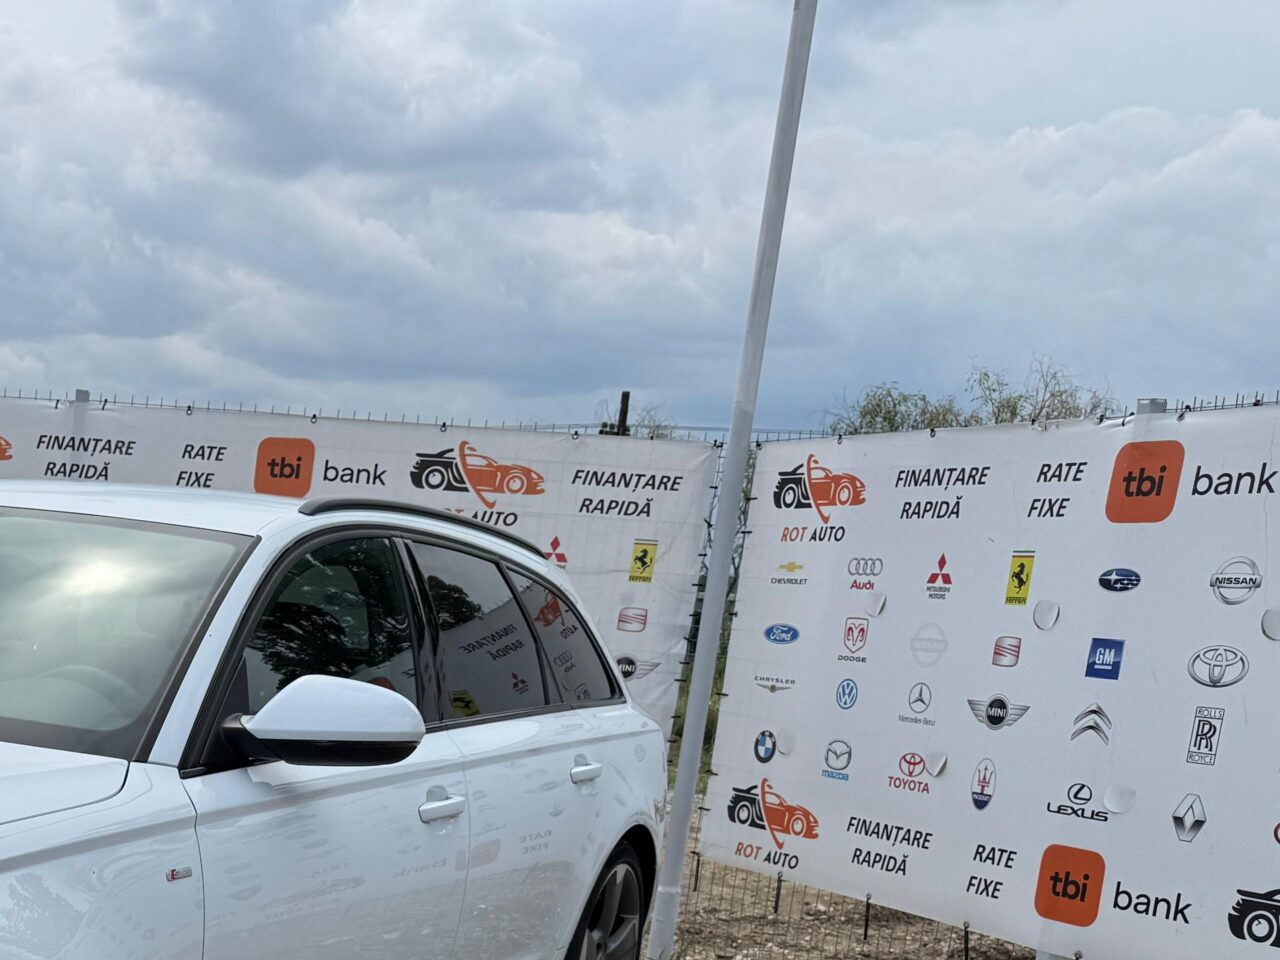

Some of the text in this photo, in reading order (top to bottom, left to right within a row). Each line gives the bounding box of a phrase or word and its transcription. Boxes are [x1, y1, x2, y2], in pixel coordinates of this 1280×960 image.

[36, 433, 137, 457] FINANȚARE
[181, 444, 227, 462] RATE
[44, 460, 111, 481] RAPIDĂ
[176, 471, 215, 488] FIXE
[267, 456, 388, 486] tbi bank
[571, 469, 684, 492] FINANȚARE
[895, 466, 991, 491] FINANȚARE
[1036, 462, 1088, 483] RATE
[1122, 463, 1280, 497] tbi bank
[579, 497, 655, 518] RAPIDĂ
[900, 495, 963, 519] RAPIDĂ
[1027, 498, 1070, 518] FIXE
[781, 525, 846, 543] ROT AUTO
[770, 577, 808, 585] CHEVROLET
[1214, 575, 1258, 585] NISSAN
[771, 627, 794, 641] Ford
[837, 655, 867, 663] DODGE
[1095, 648, 1116, 665] GM
[754, 675, 796, 685] CHRYSLER
[988, 706, 1007, 718] MINI
[1198, 708, 1223, 718] ROLLS
[1188, 753, 1215, 764] ROYCE
[888, 776, 930, 794] TOYOTA
[1046, 802, 1108, 822] LEXUS
[846, 816, 933, 850] FINANȚARE
[734, 841, 800, 870] ROT AUTO
[851, 848, 909, 876] RAPIDĂ
[973, 844, 1018, 870] RATE
[966, 875, 1003, 900] FIXE
[1049, 871, 1193, 925] tbi bank
